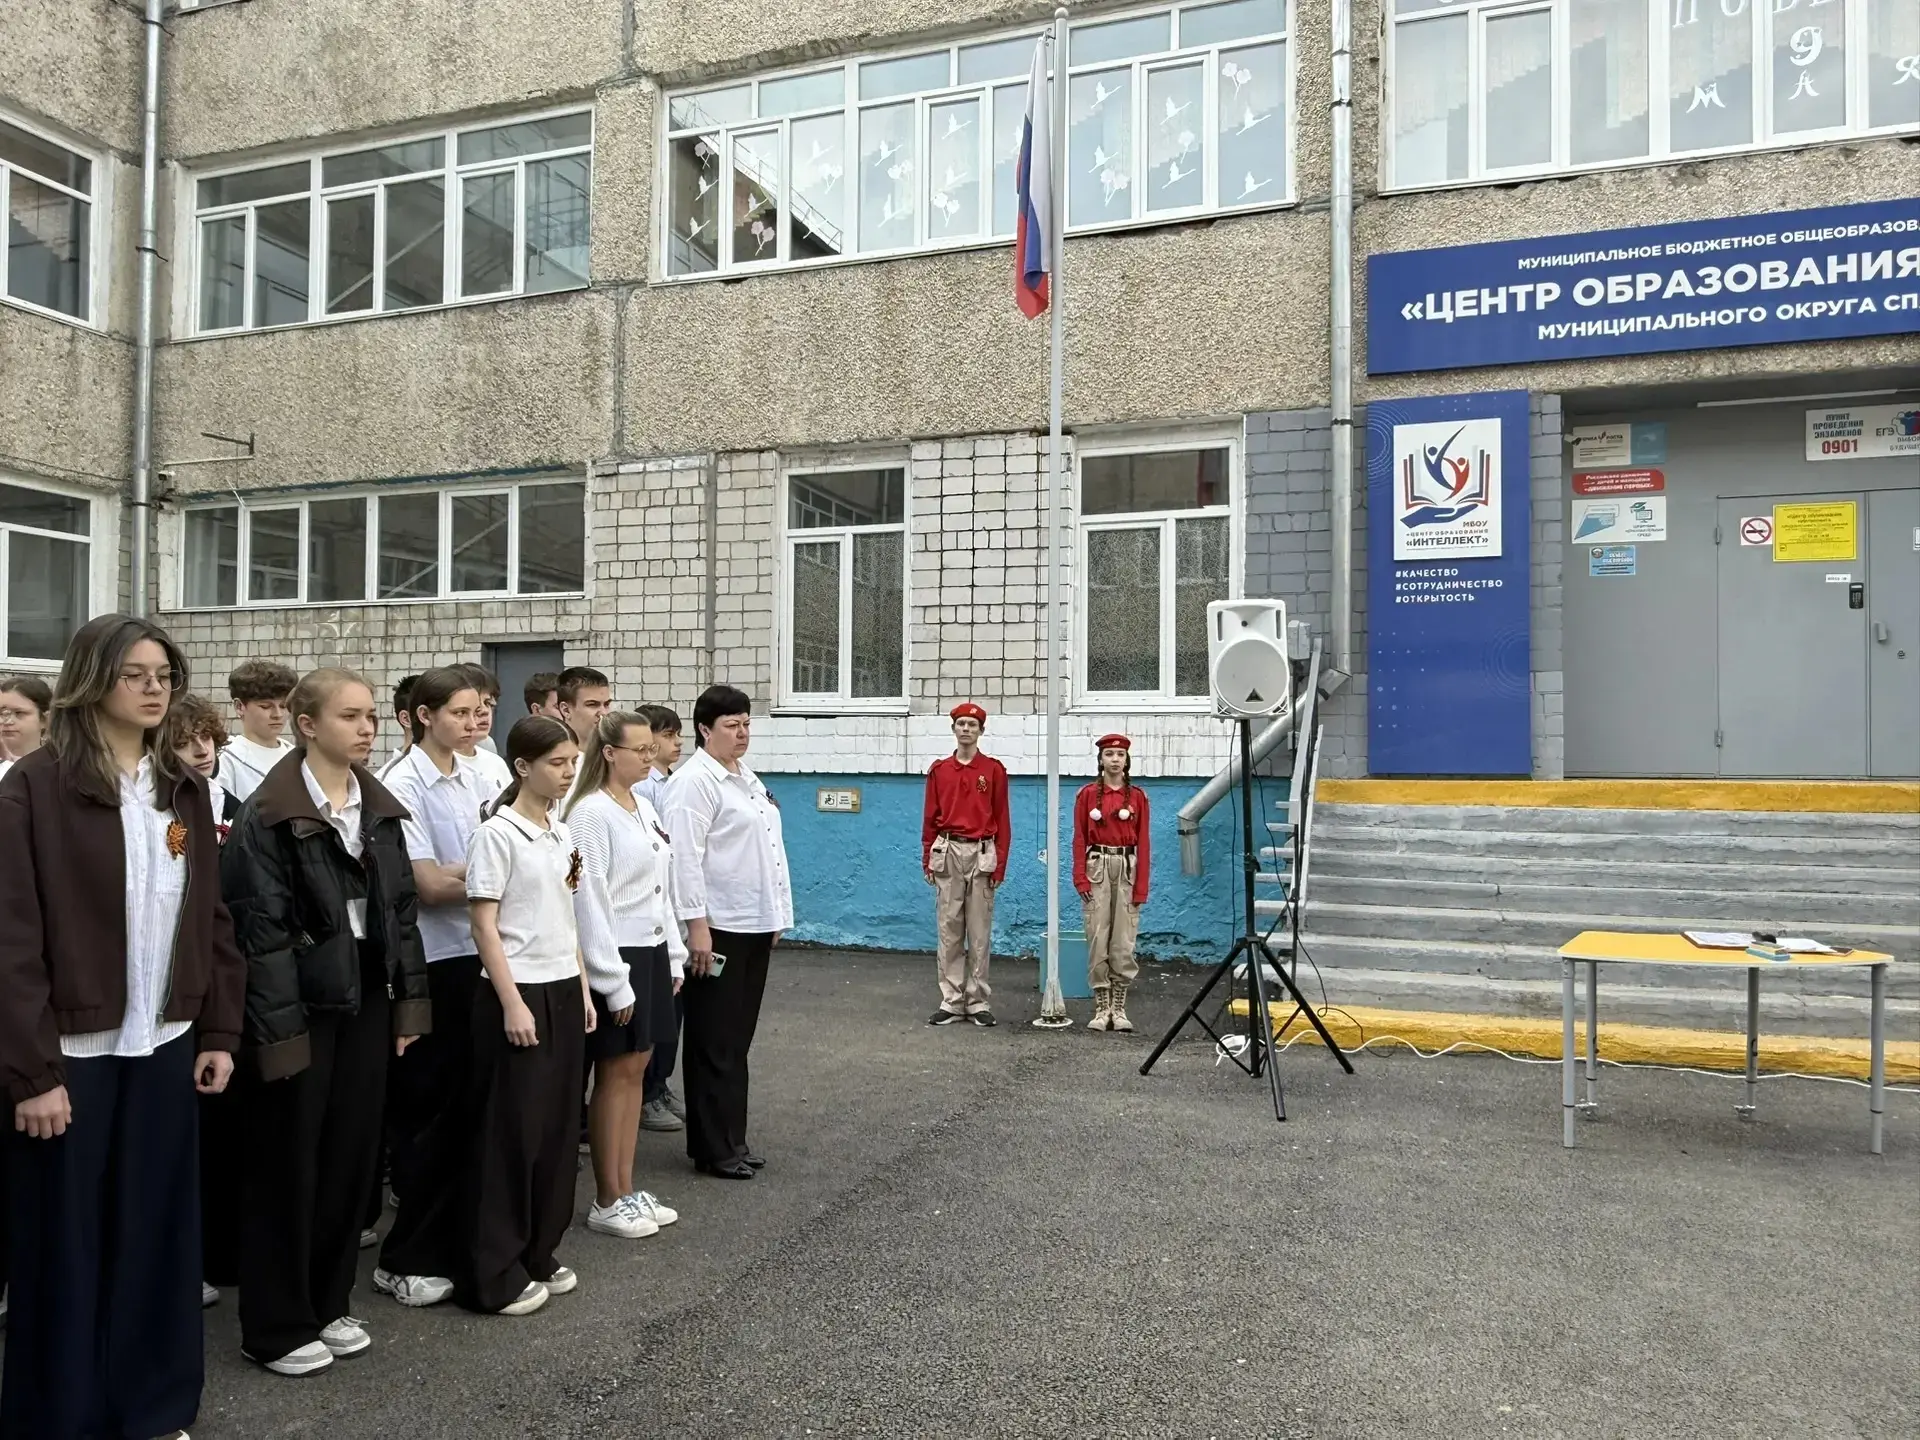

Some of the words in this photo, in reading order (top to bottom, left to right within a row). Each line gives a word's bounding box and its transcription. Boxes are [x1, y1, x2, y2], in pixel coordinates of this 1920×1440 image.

[1790, 26, 1823, 66] 9
[1518, 245, 1662, 270] МУНИЦИПАЛЬНОЕ
[1666, 233, 1777, 255] БЮДЖЕТНОЕ
[1780, 219, 1920, 243] ОБЩЕОБРАЗОВ
[1401, 282, 1561, 324] «ЦЕНТР
[1572, 247, 1920, 307] ОБРАЗОВАНИЯ
[1538, 306, 1767, 340] МУНИЦИПАЛЬНОГО
[1776, 297, 1877, 321] ОКРУГА
[1883, 293, 1920, 311] СП
[1876, 427, 1895, 436] ЕГЭ
[1822, 439, 1858, 454] 0901
[1406, 535, 1489, 547] «ИНТЕЛЛЕКТ»
[1395, 568, 1459, 578] #КАЧЕСТВО
[1395, 579, 1503, 591] #СОТРУДНИЧЕСТВО
[1395, 593, 1475, 603] #ОТКРЫТОСТЬ
